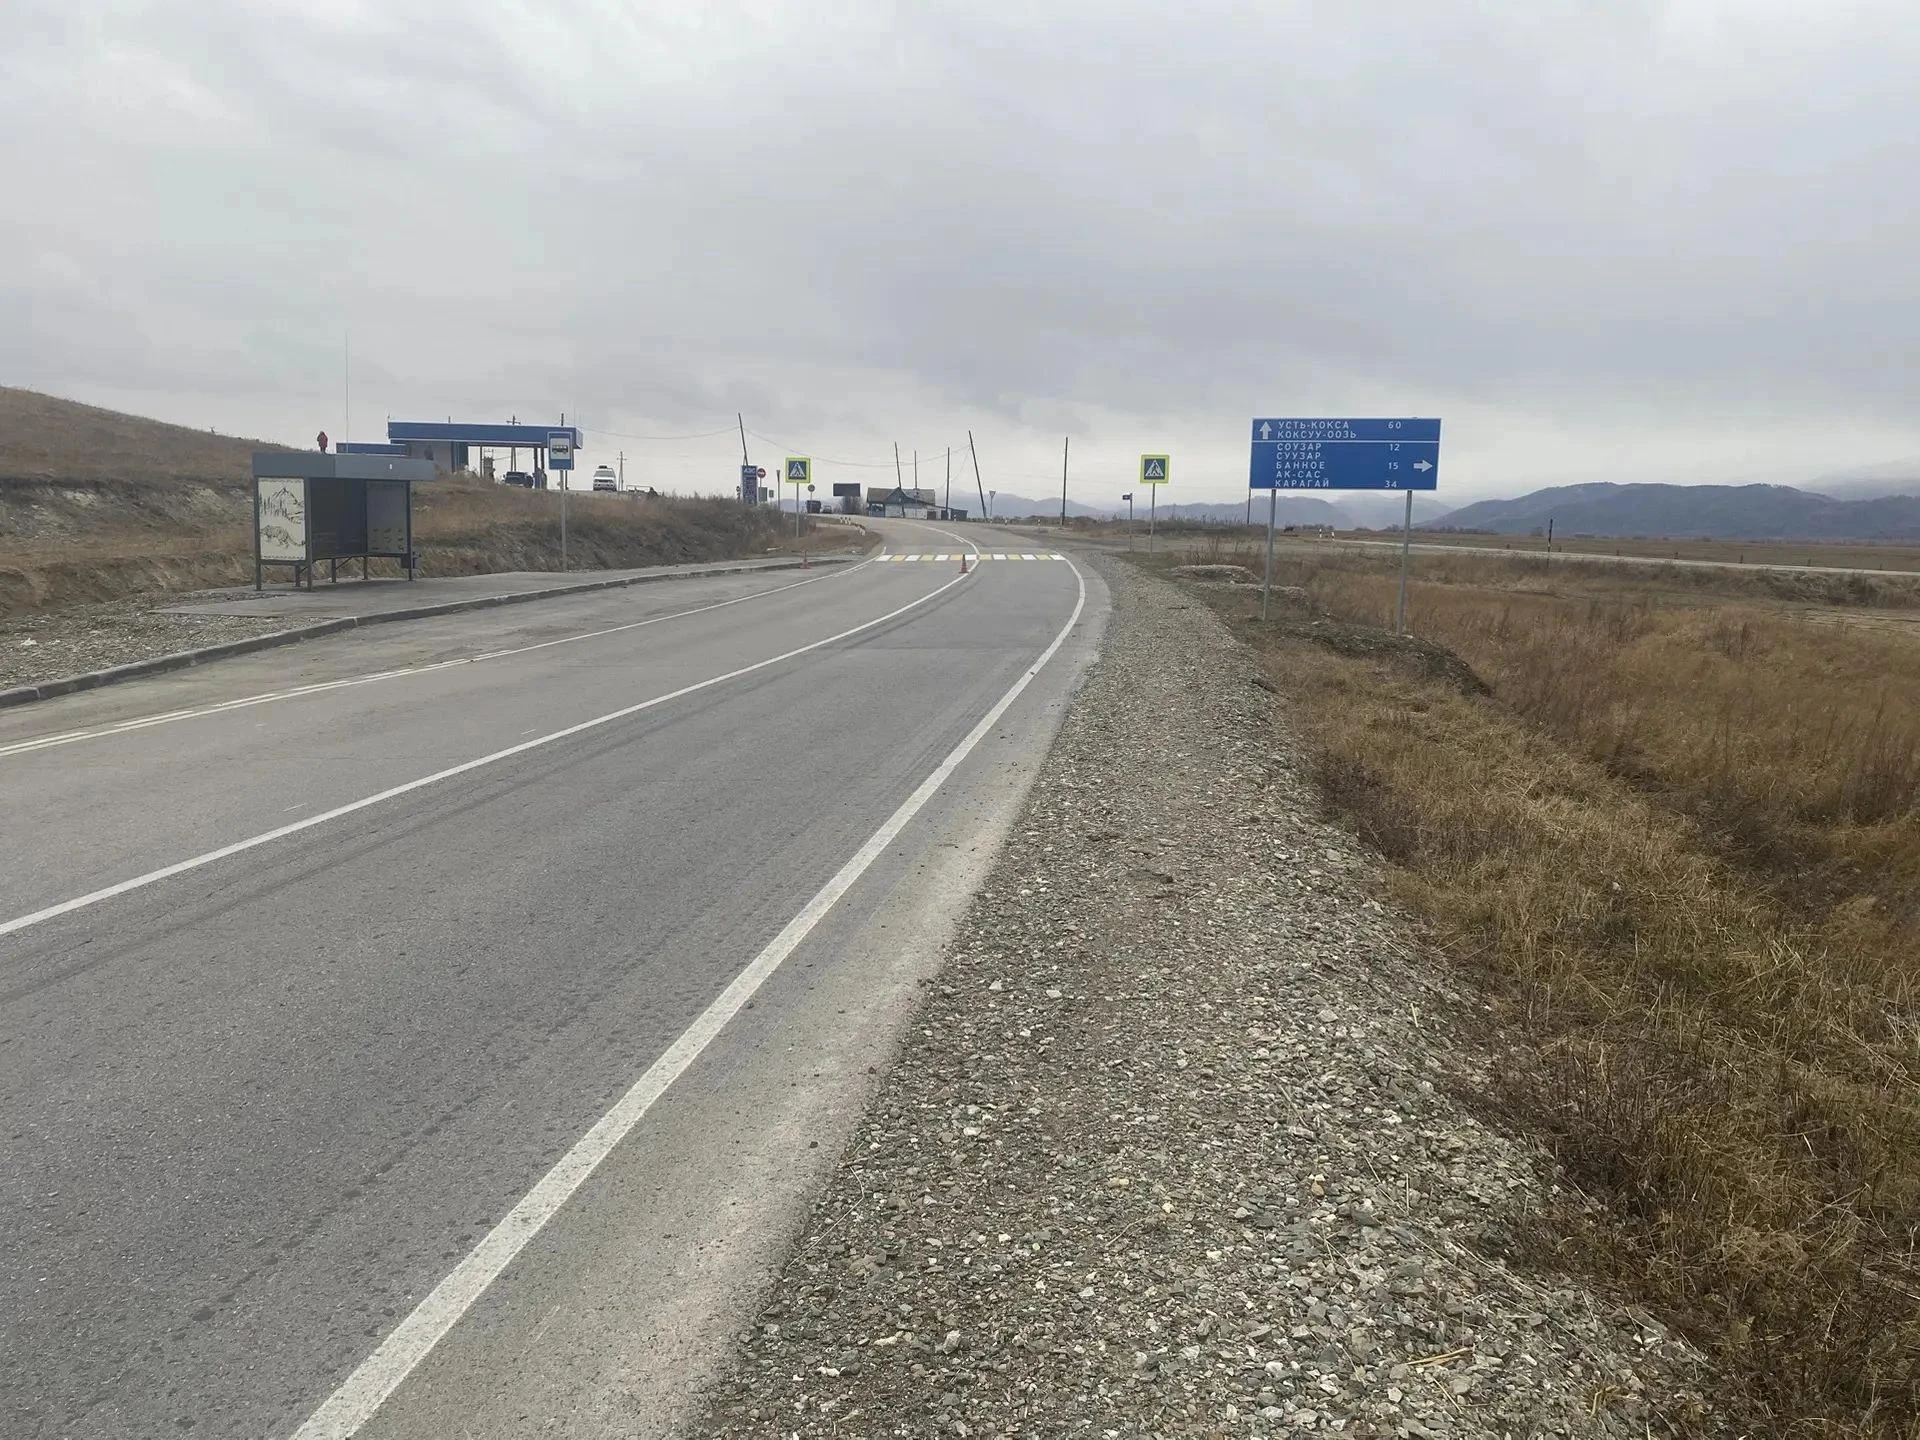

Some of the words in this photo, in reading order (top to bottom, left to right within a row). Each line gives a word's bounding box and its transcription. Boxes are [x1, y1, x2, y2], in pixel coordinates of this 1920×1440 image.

[1278, 420, 1349, 429] УСТЬ-КОКСА
[1388, 421, 1401, 429] 60
[1277, 430, 1357, 439] КОКСУУ-ООЗЬ
[1276, 442, 1322, 451] СОУЗАР
[1389, 443, 1400, 451] 12
[1276, 451, 1321, 460] СУУЗАР
[1275, 461, 1325, 469] БАННОЕ
[1388, 462, 1399, 470] 15
[1275, 470, 1321, 478] АК-САС
[1274, 478, 1329, 488] КАРАГАЙ
[1384, 480, 1397, 488] 34
